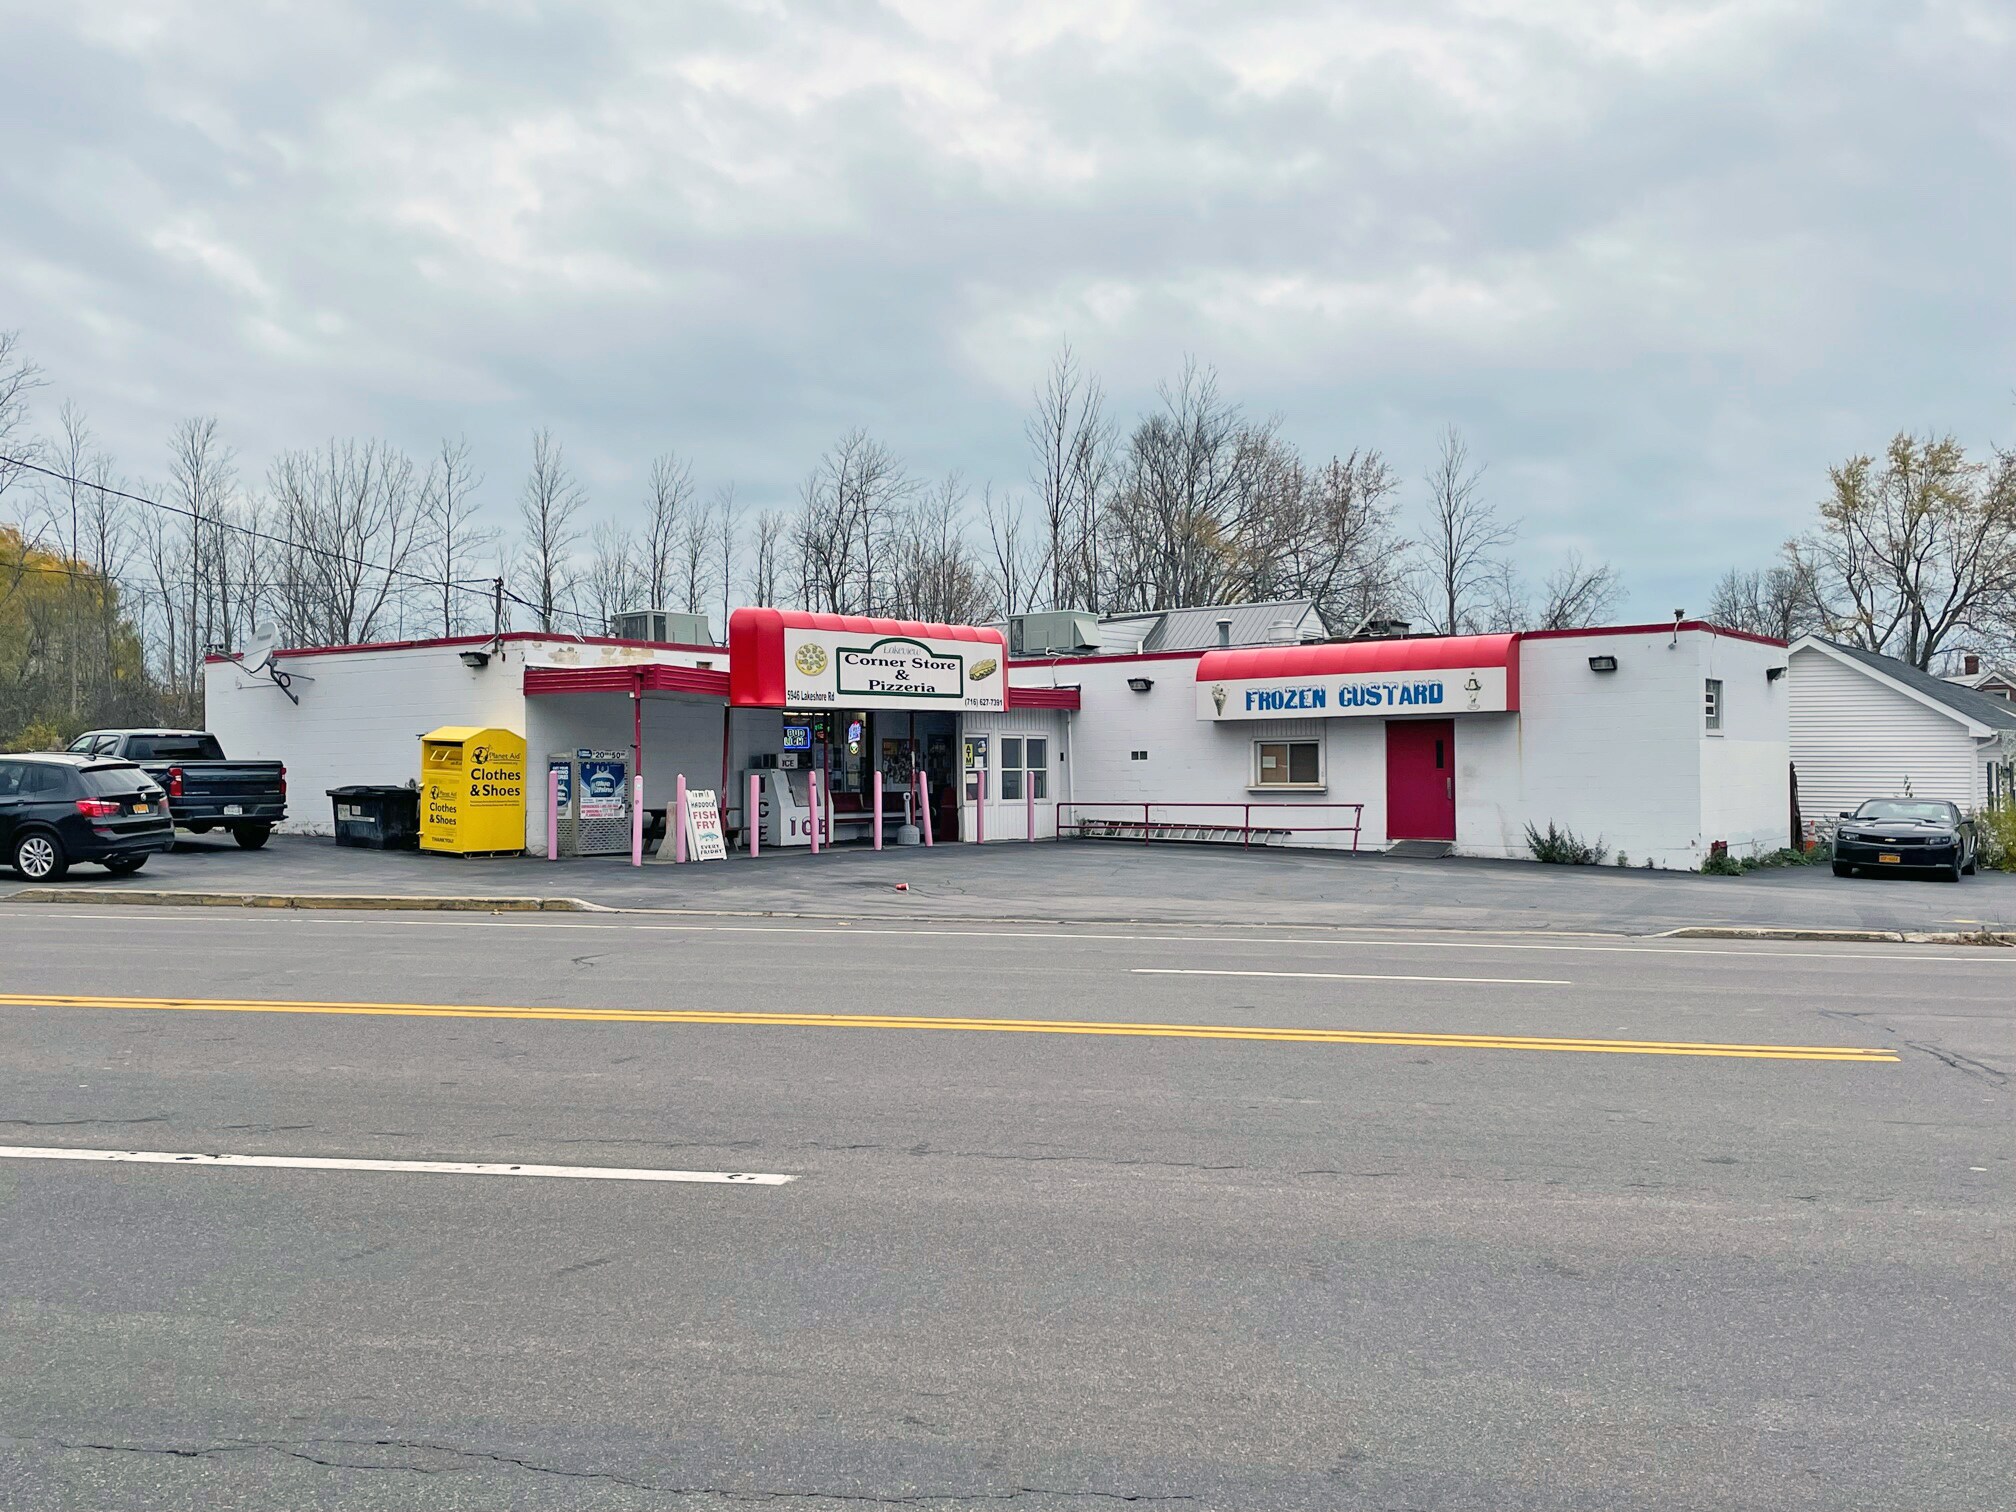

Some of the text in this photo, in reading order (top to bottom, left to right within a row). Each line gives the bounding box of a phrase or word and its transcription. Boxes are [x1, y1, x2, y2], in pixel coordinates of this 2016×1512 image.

[883, 644, 922, 656] Lakeview
[844, 653, 956, 670] Corner Store
[895, 669, 910, 681] &
[868, 679, 936, 693] Pizzeria
[787, 690, 835, 702] 5946 Lakeshore Rd
[1245, 678, 1444, 711] FROZEN CUSTARD
[964, 697, 979, 707] (716)
[786, 728, 806, 737] BUD
[489, 752, 521, 760] Planet Aid
[781, 759, 795, 768] ICE
[470, 768, 521, 781] Clothes
[469, 784, 521, 797] & Shoes
[429, 802, 457, 814] Clothes
[429, 814, 457, 826] & Shoes
[692, 810, 718, 820] FISH
[696, 820, 716, 830] FRY
